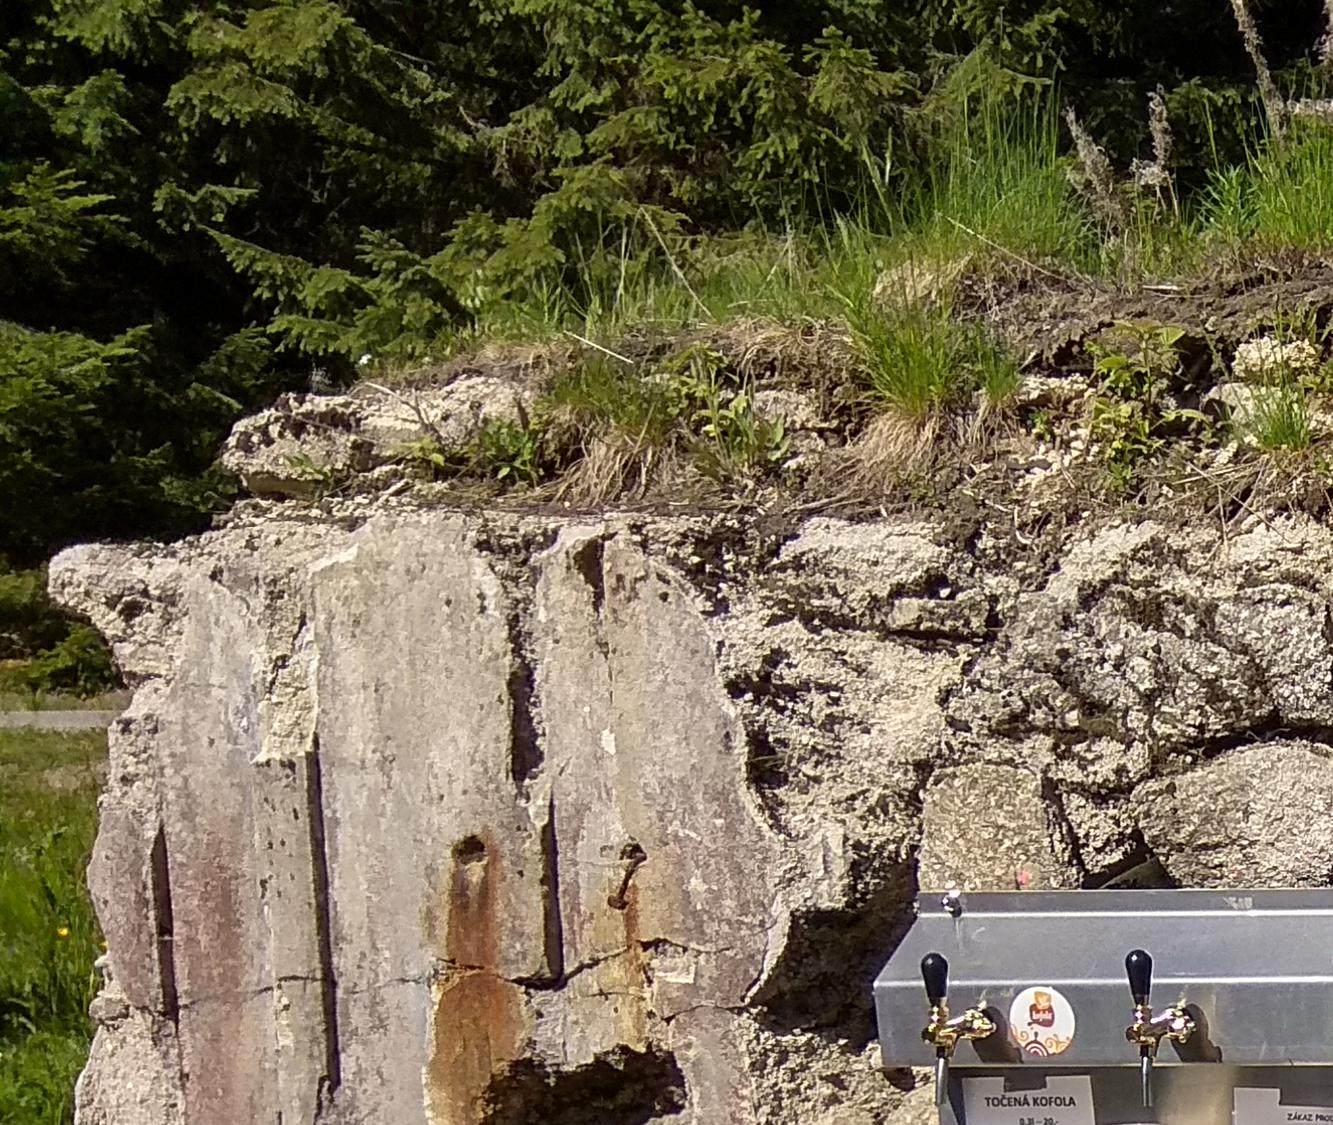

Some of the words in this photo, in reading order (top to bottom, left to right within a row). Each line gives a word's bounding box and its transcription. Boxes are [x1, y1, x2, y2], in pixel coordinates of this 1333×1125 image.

[985, 1094, 1030, 1107] TOČENÁ
[1033, 1096, 1076, 1107] KOFOLA
[1287, 1112, 1313, 1122] ZÁKAZ
